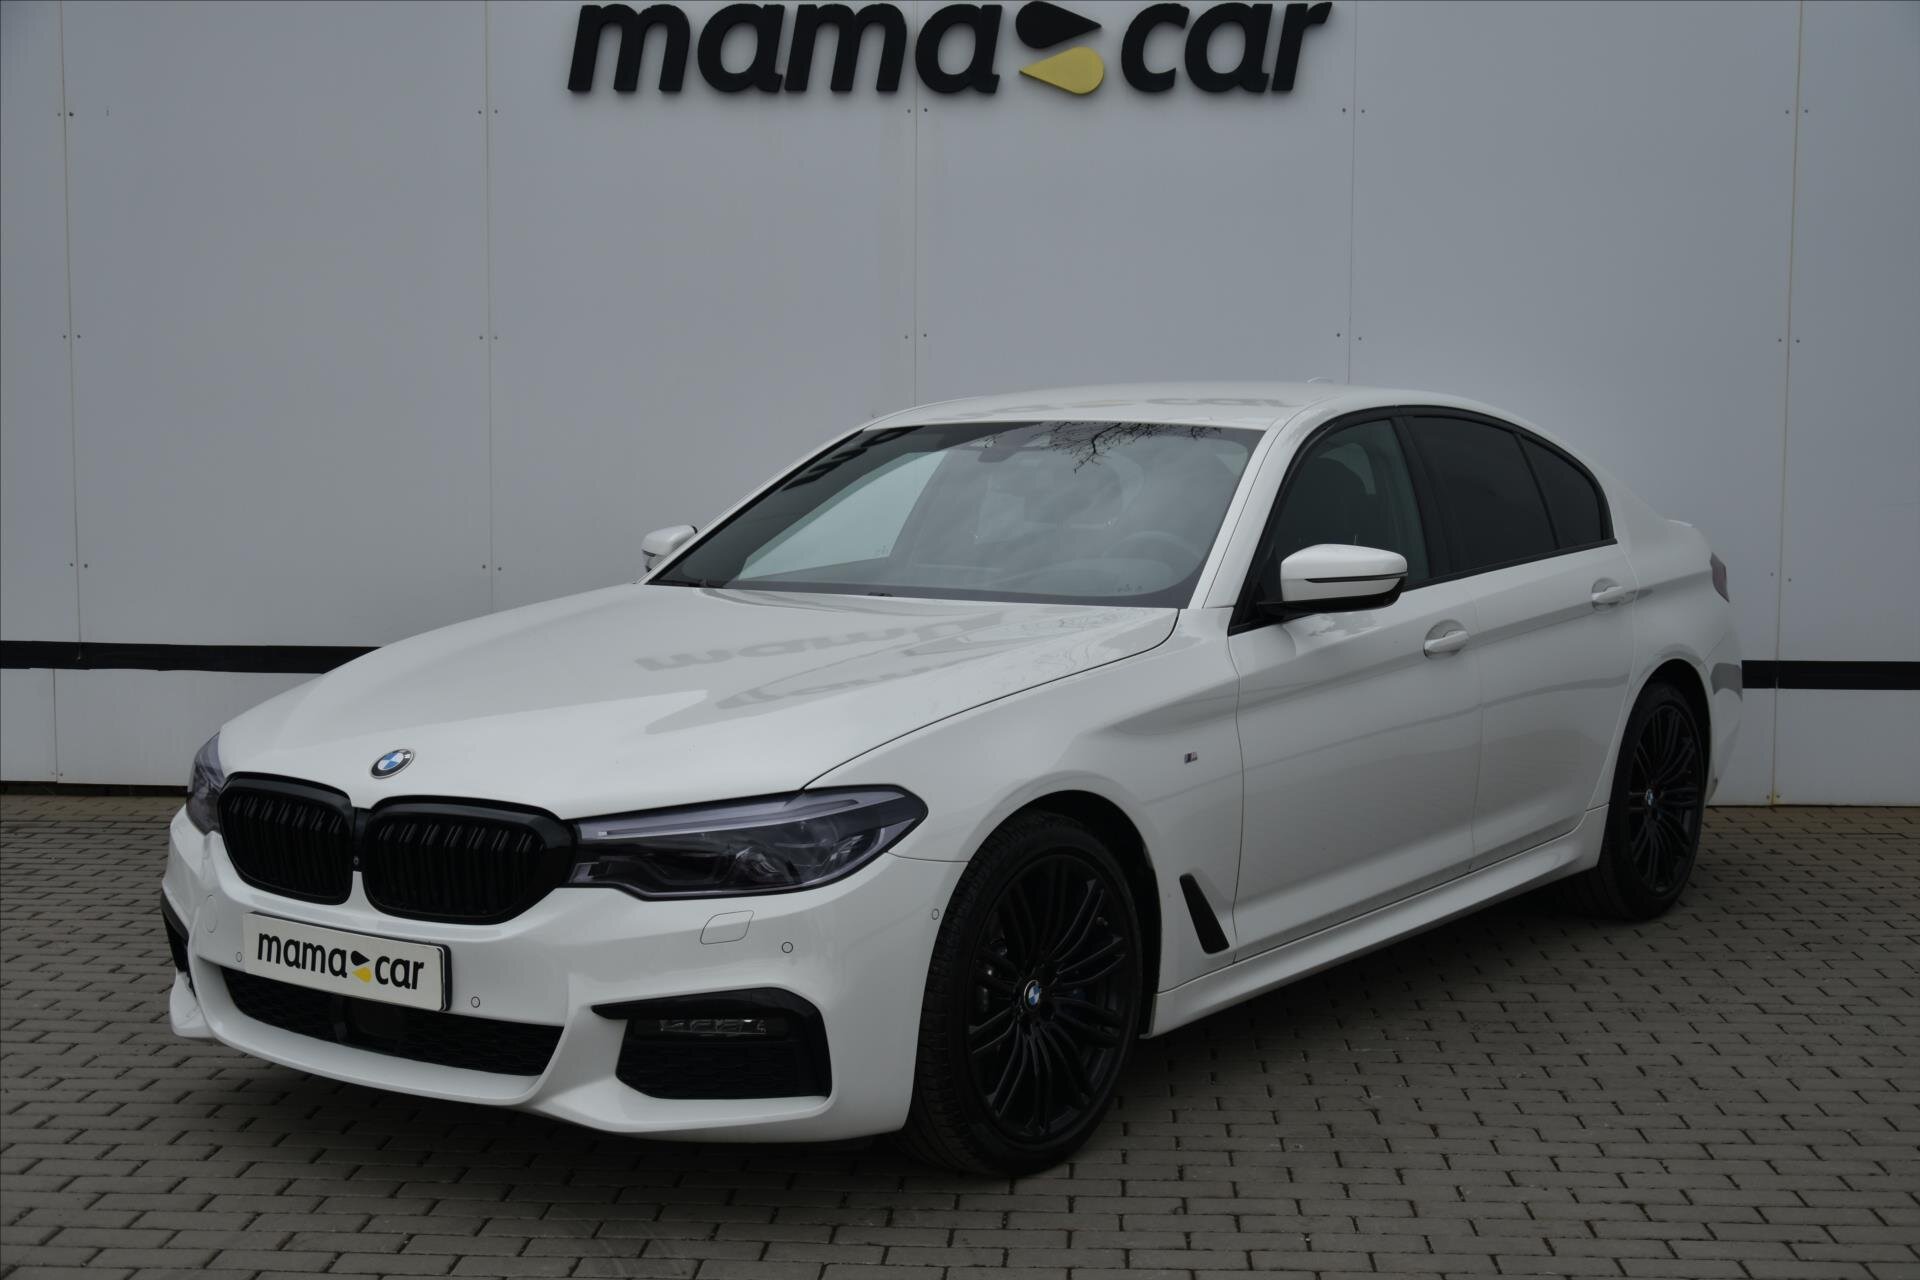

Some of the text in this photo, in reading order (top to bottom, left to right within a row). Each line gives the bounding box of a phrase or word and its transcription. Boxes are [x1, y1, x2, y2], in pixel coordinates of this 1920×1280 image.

[567, 1, 1333, 98] mama car
[257, 932, 425, 990] mama car
